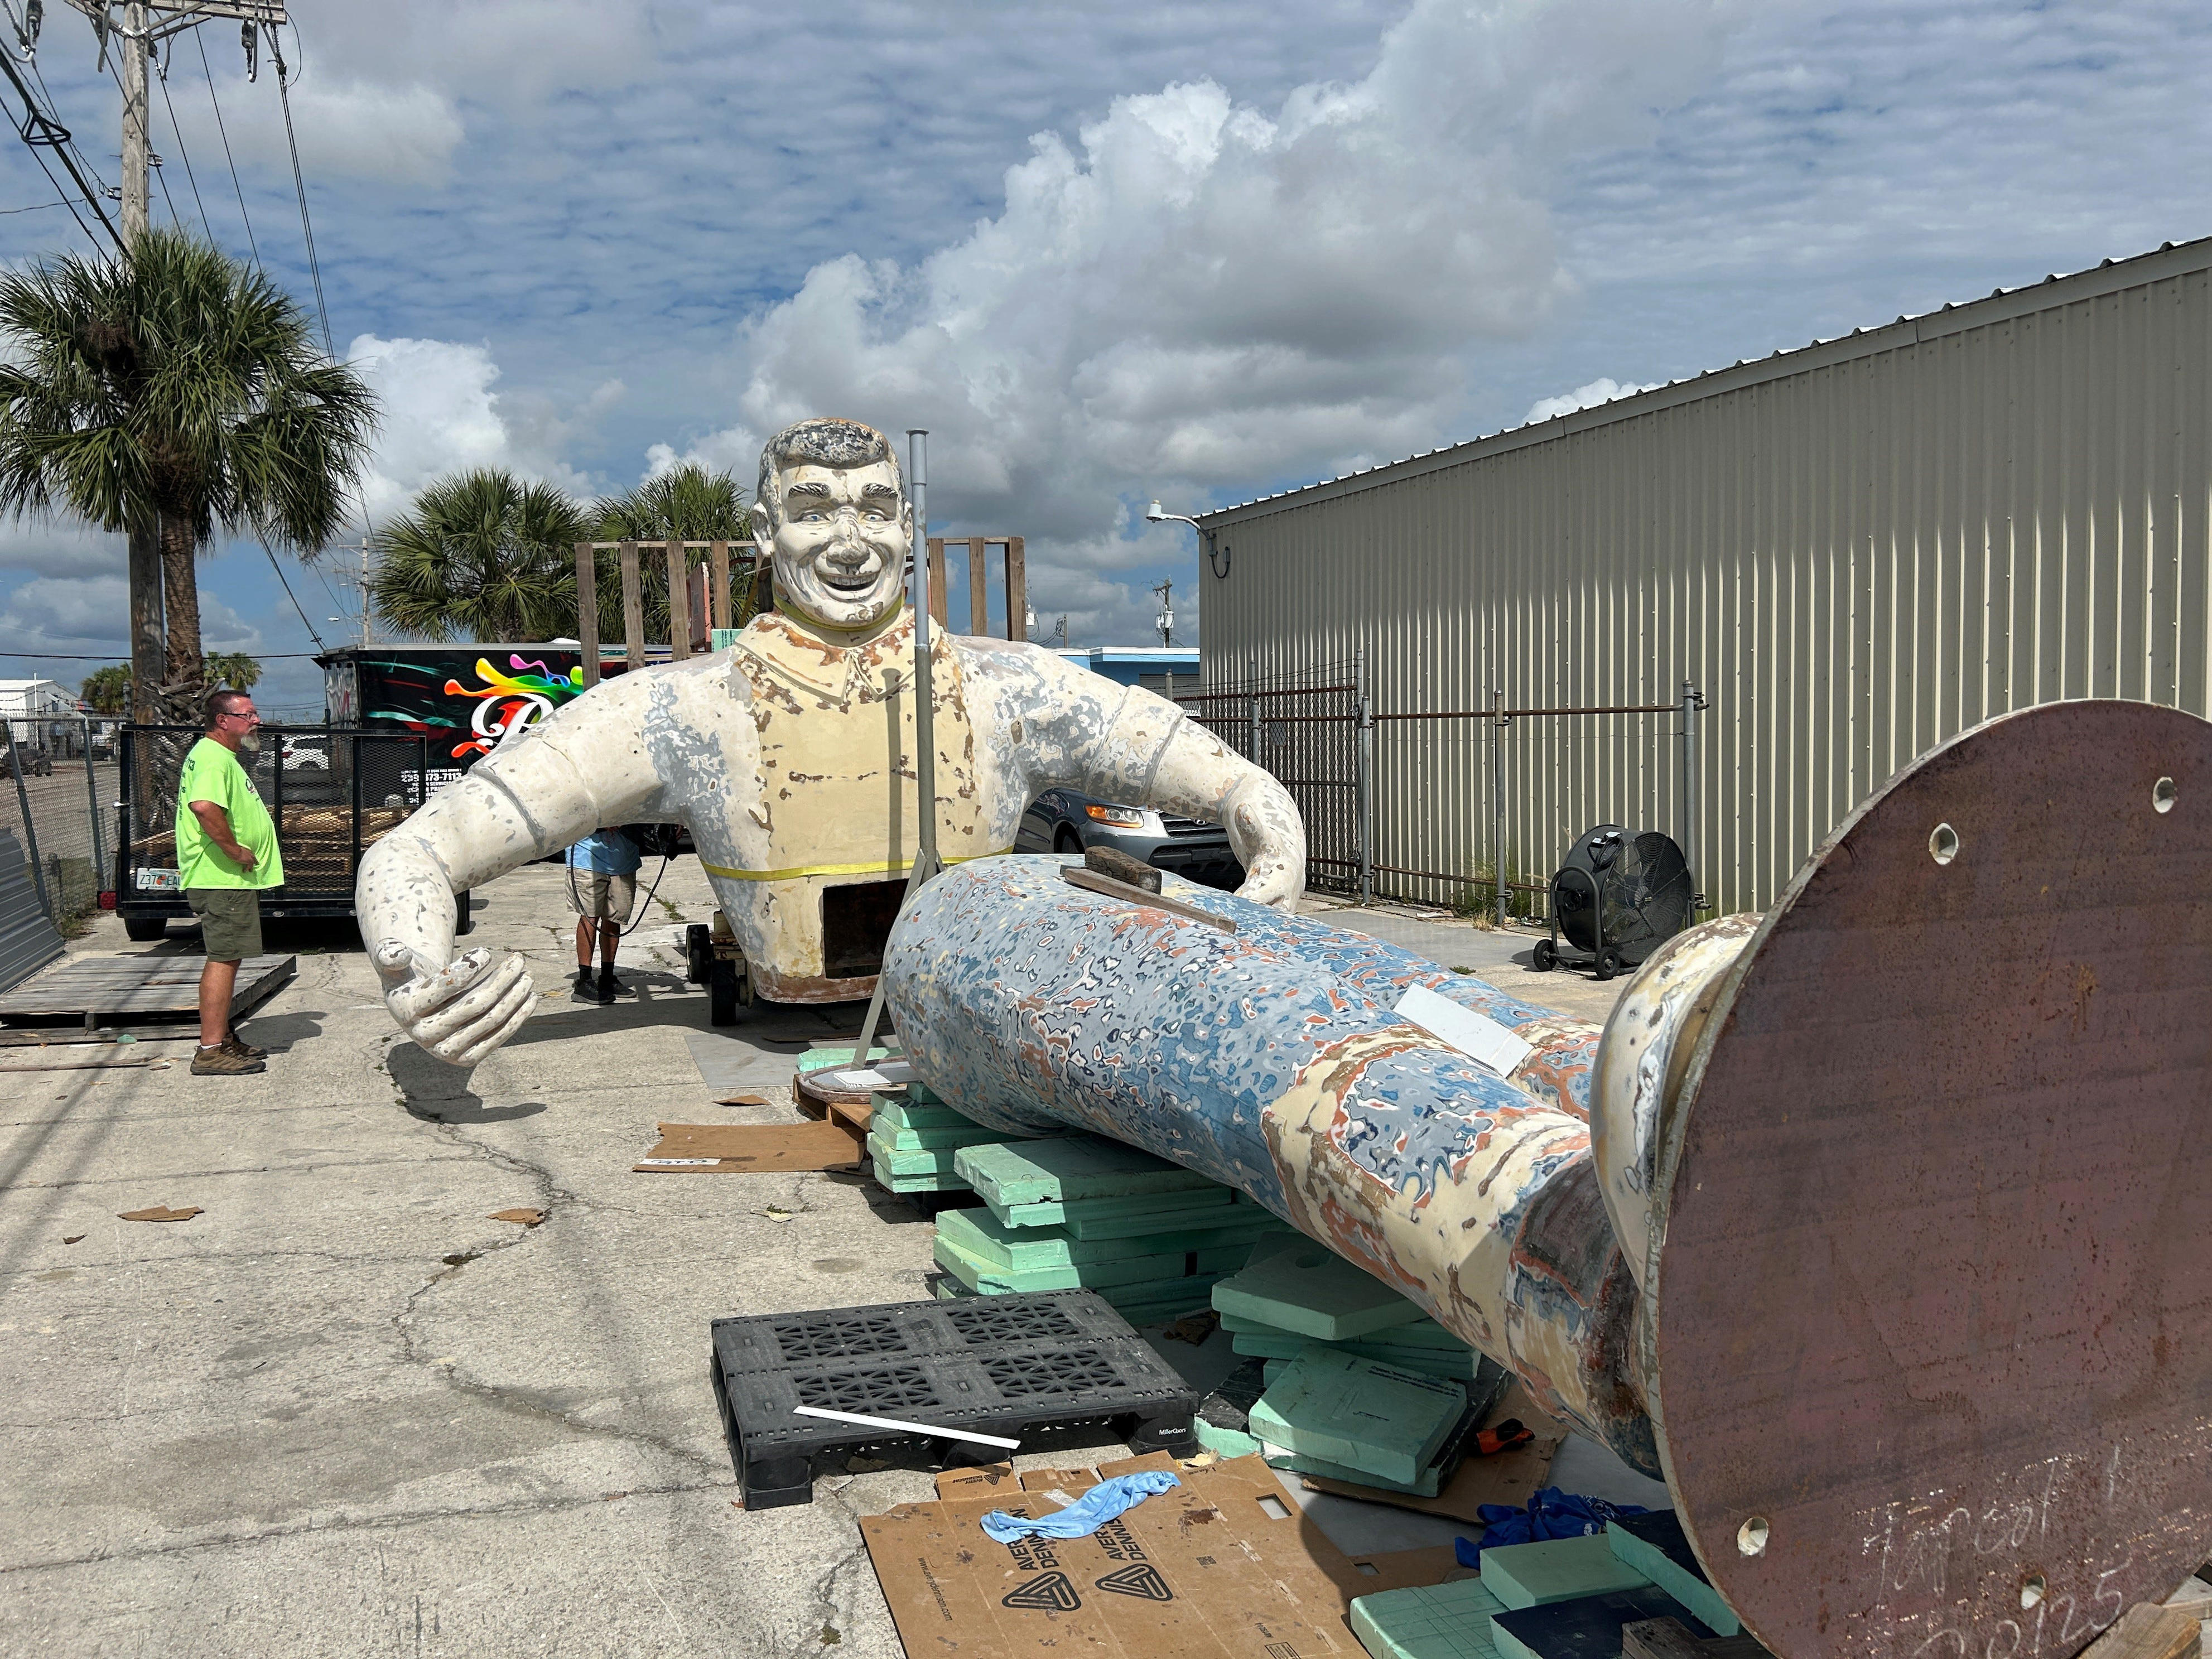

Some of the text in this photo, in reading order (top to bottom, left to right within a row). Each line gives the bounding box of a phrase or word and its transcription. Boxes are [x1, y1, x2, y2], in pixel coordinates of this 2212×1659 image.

[140, 874, 156, 885] Z37
[1006, 1538, 1038, 1570] AVER
[1009, 1508, 1060, 1569] DENNN
[1093, 1526, 1127, 1561] AVER
[1107, 1518, 1148, 1561] DENNIS
[917, 1557, 953, 1621] www.averydennison.com
